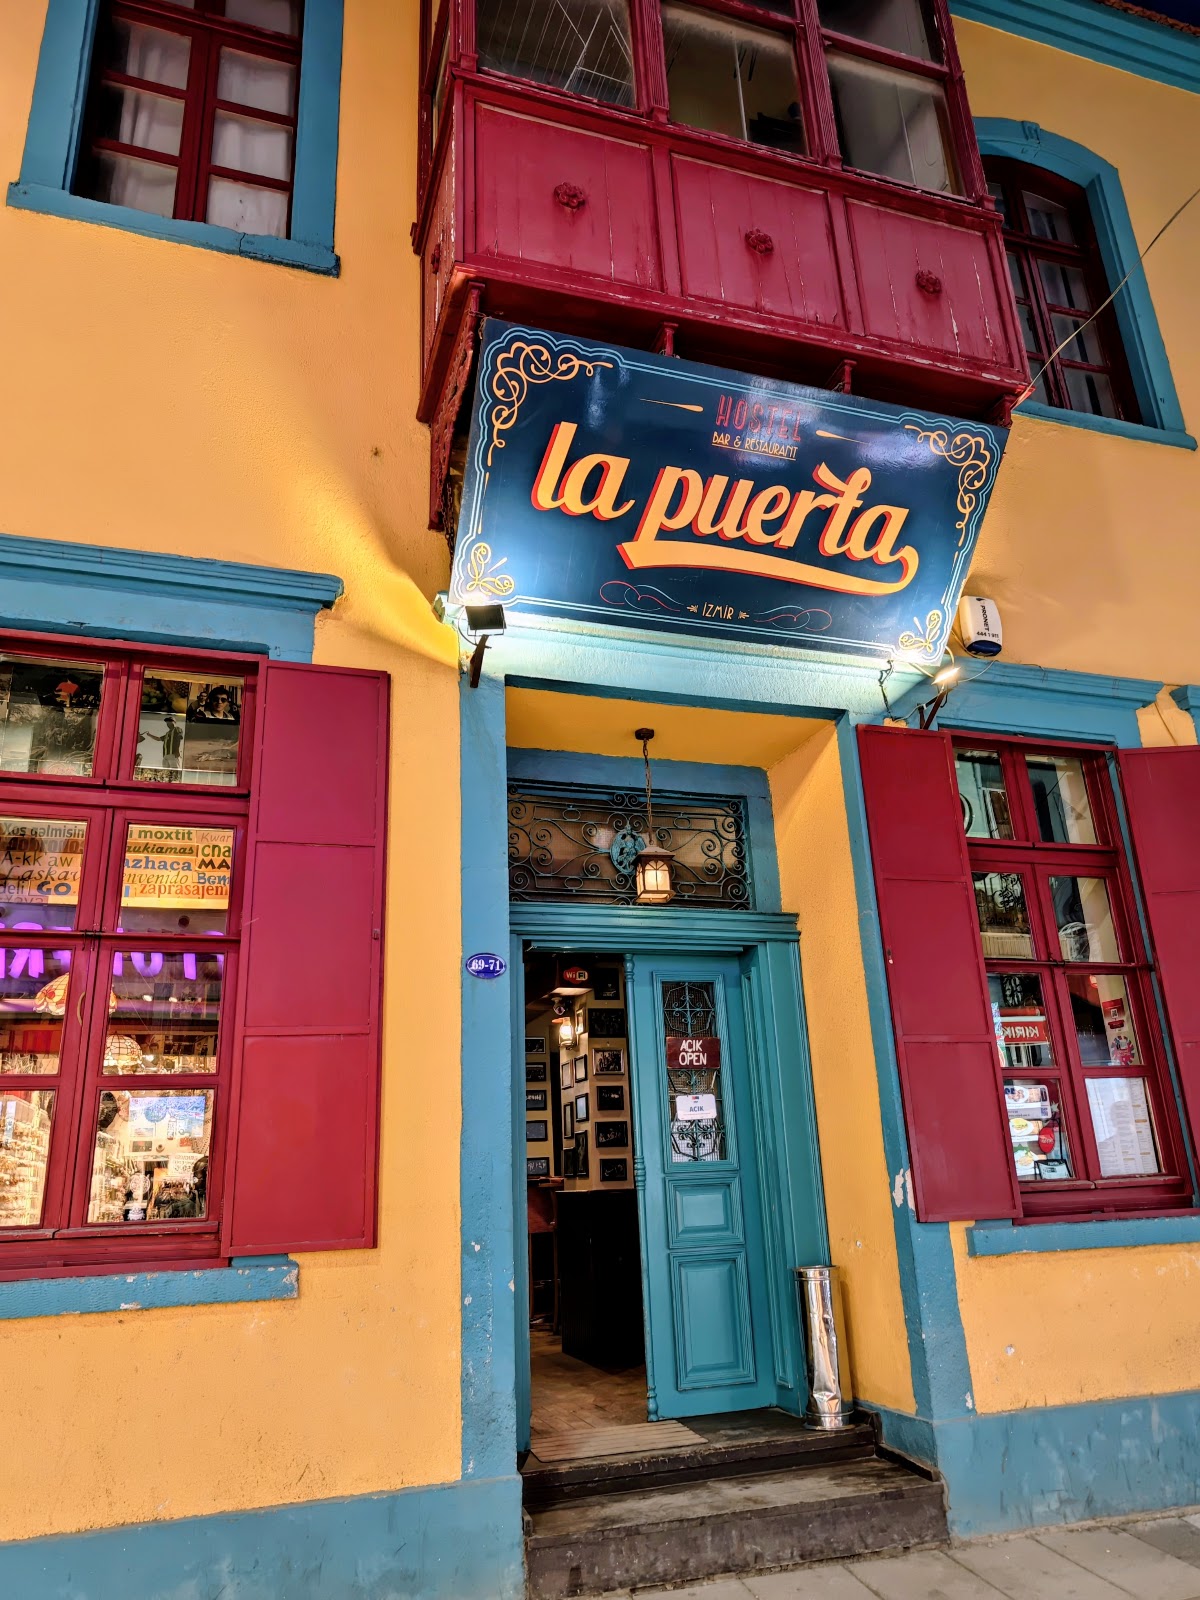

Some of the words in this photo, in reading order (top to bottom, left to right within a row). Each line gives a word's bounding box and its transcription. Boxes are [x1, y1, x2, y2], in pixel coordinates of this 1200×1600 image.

[715, 394, 801, 442] HOSTEL
[712, 431, 731, 446] BAR
[733, 435, 741, 448] &
[744, 438, 798, 458] RESTAURANT
[531, 421, 635, 522] la
[617, 461, 919, 595] puerta
[981, 604, 990, 632] PRONET
[138, 829, 192, 840] moxtit
[199, 858, 231, 870] MA
[470, 959, 500, 971] 69-71
[680, 1039, 702, 1052] AÇIK
[679, 1052, 707, 1066] OPEN
